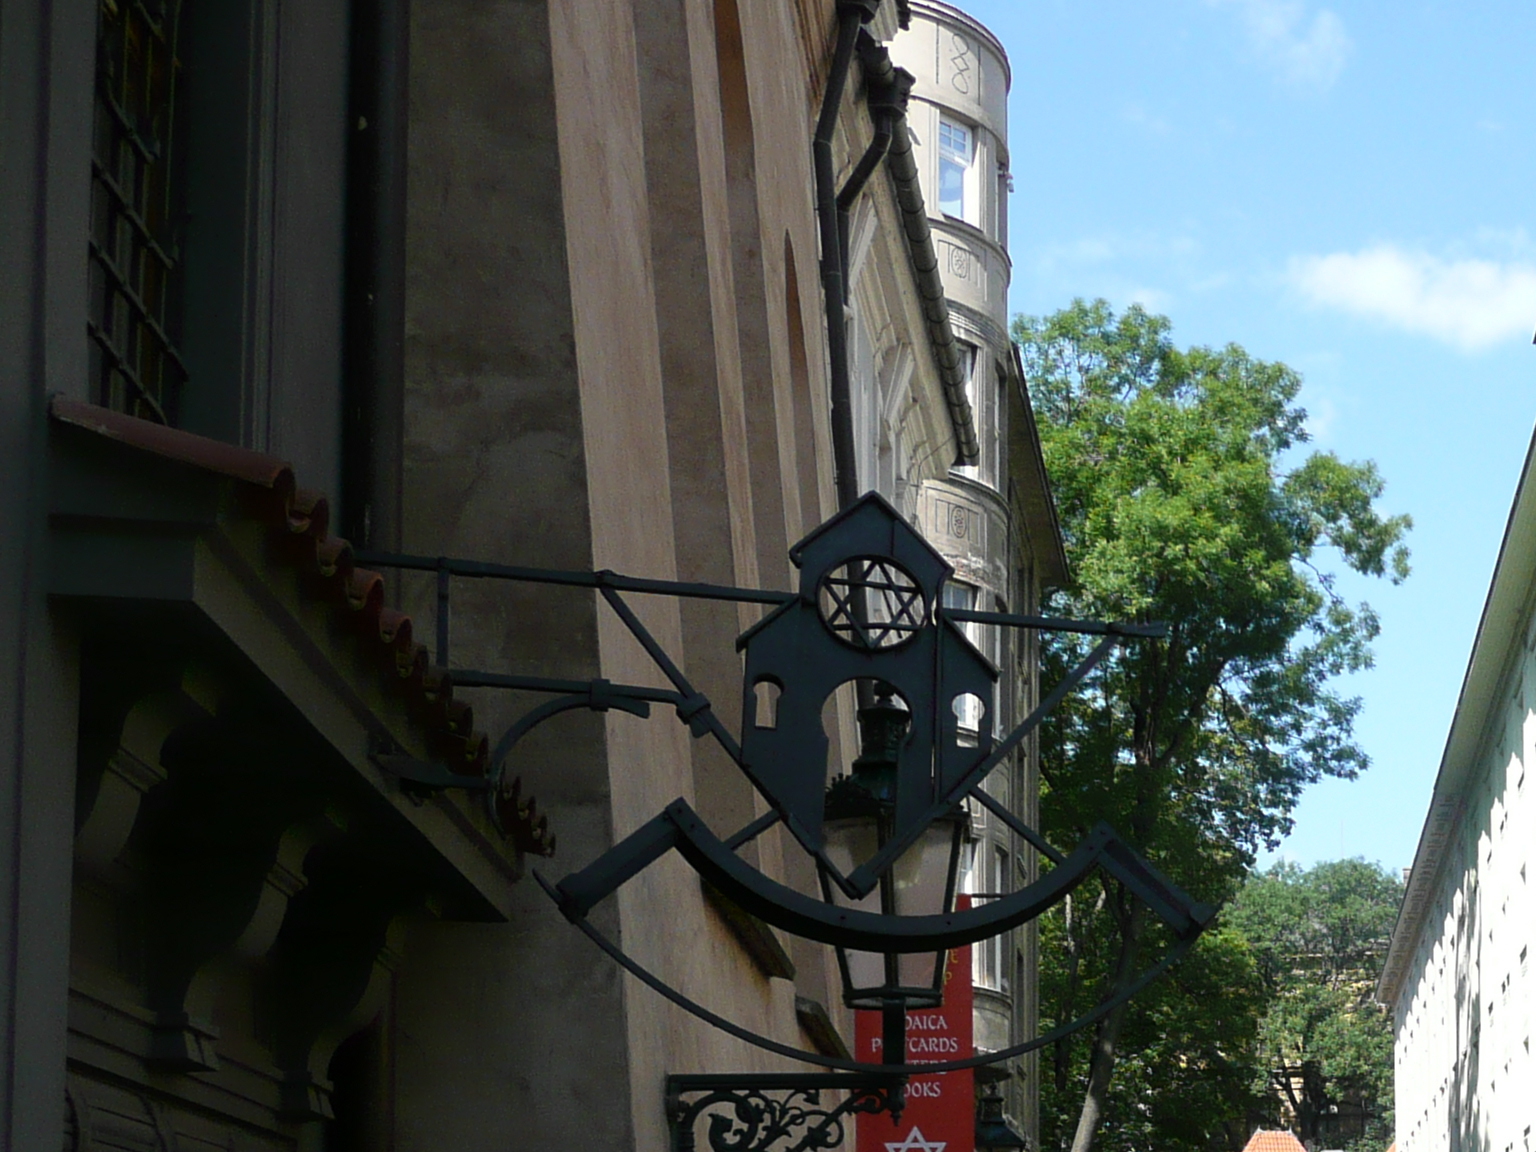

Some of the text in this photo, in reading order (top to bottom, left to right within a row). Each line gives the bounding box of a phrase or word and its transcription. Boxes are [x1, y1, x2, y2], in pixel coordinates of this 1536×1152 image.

[905, 1015, 948, 1030] DAICA
[871, 1037, 958, 1053] PCARDS
[904, 1081, 941, 1097] OOKS
